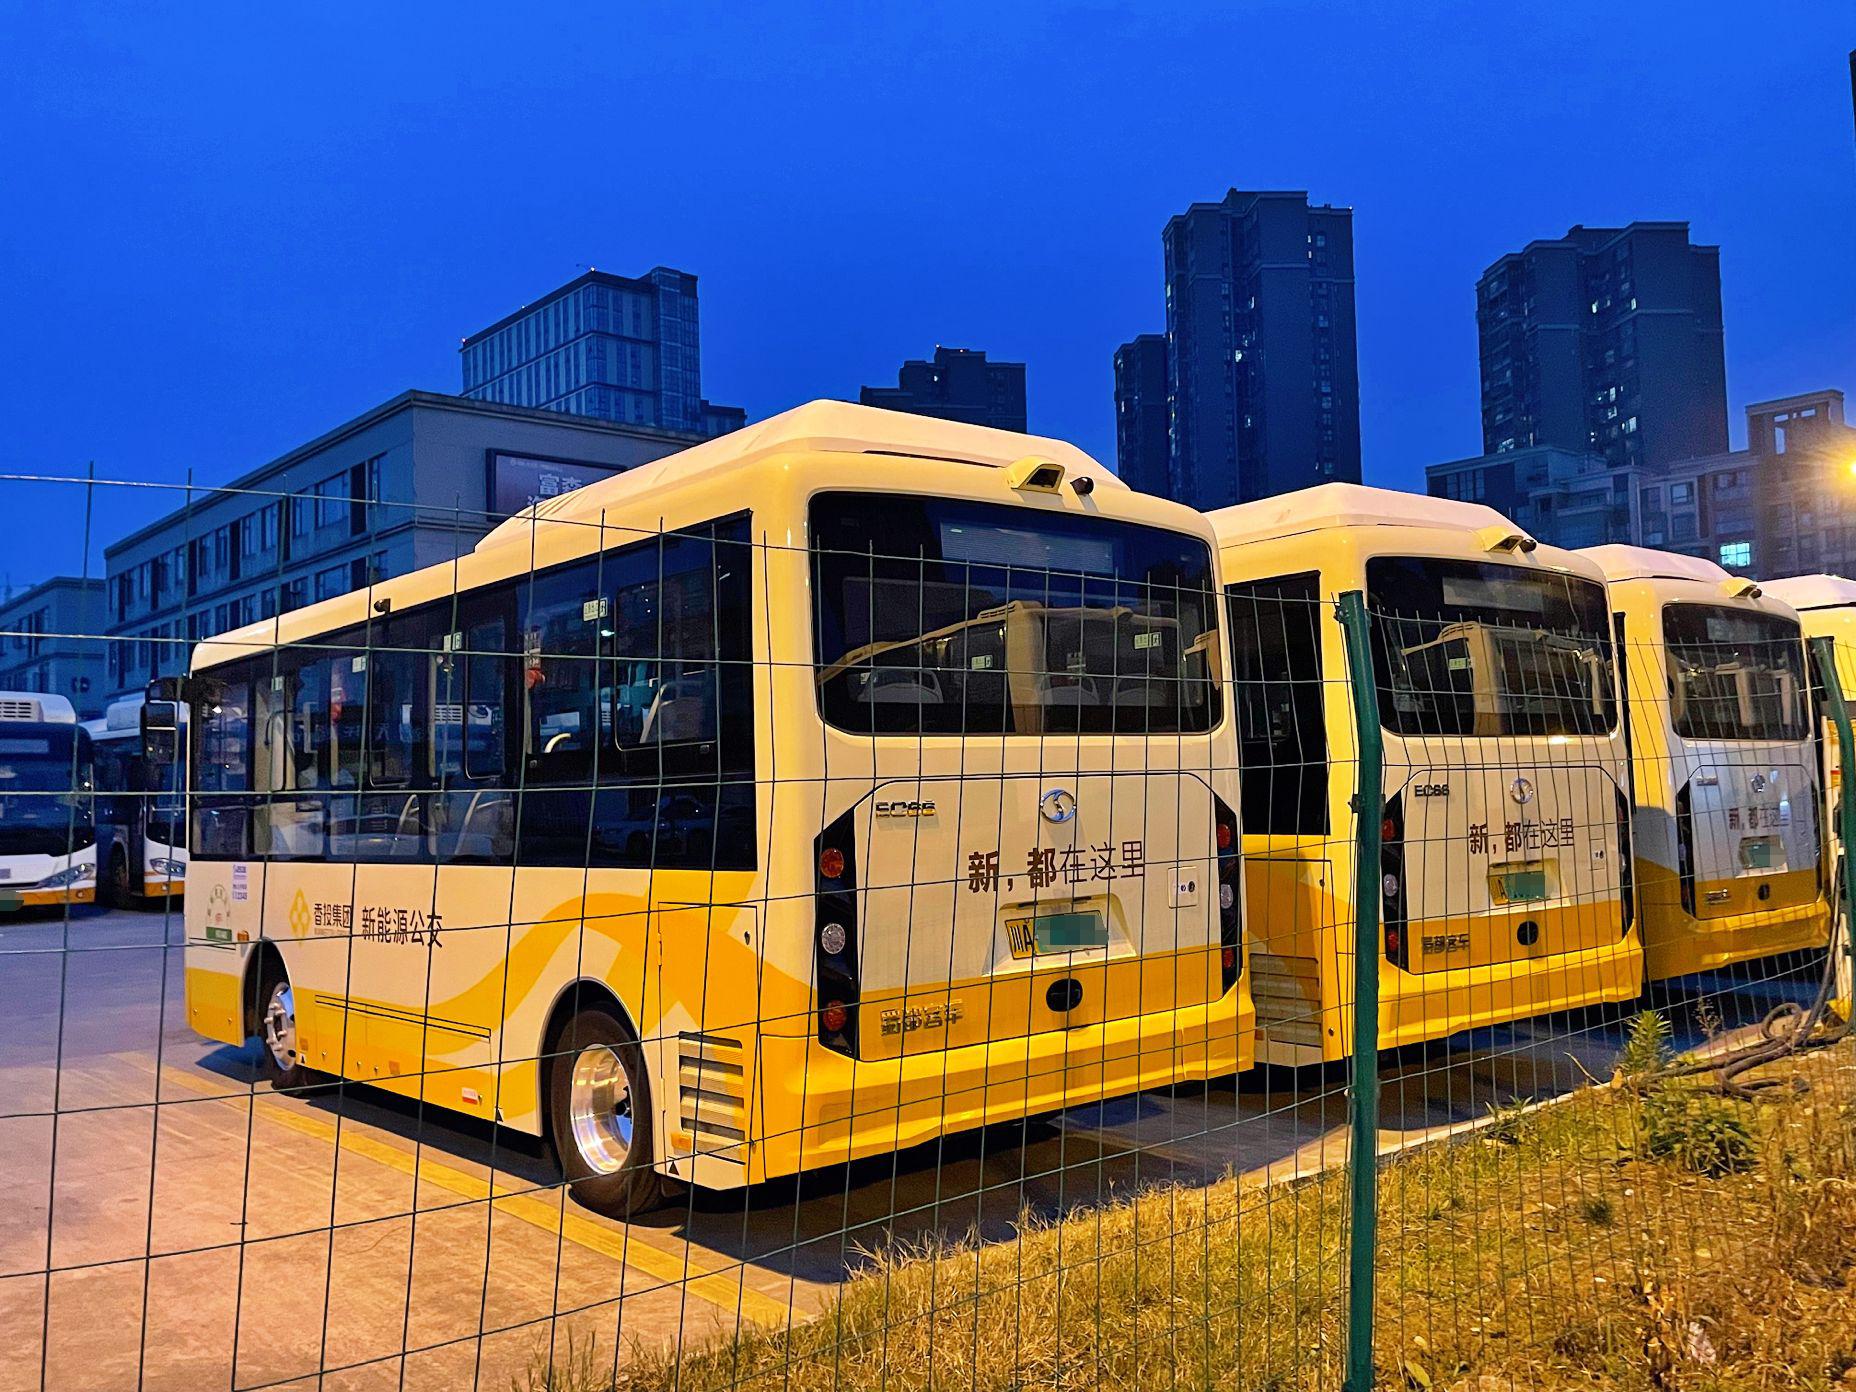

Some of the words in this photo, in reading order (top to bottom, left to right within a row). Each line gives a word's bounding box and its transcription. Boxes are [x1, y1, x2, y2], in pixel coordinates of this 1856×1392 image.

[968, 840, 1146, 893] 新，都在这里
[314, 902, 352, 928] 香投集团
[362, 906, 443, 948] 新能源公交
